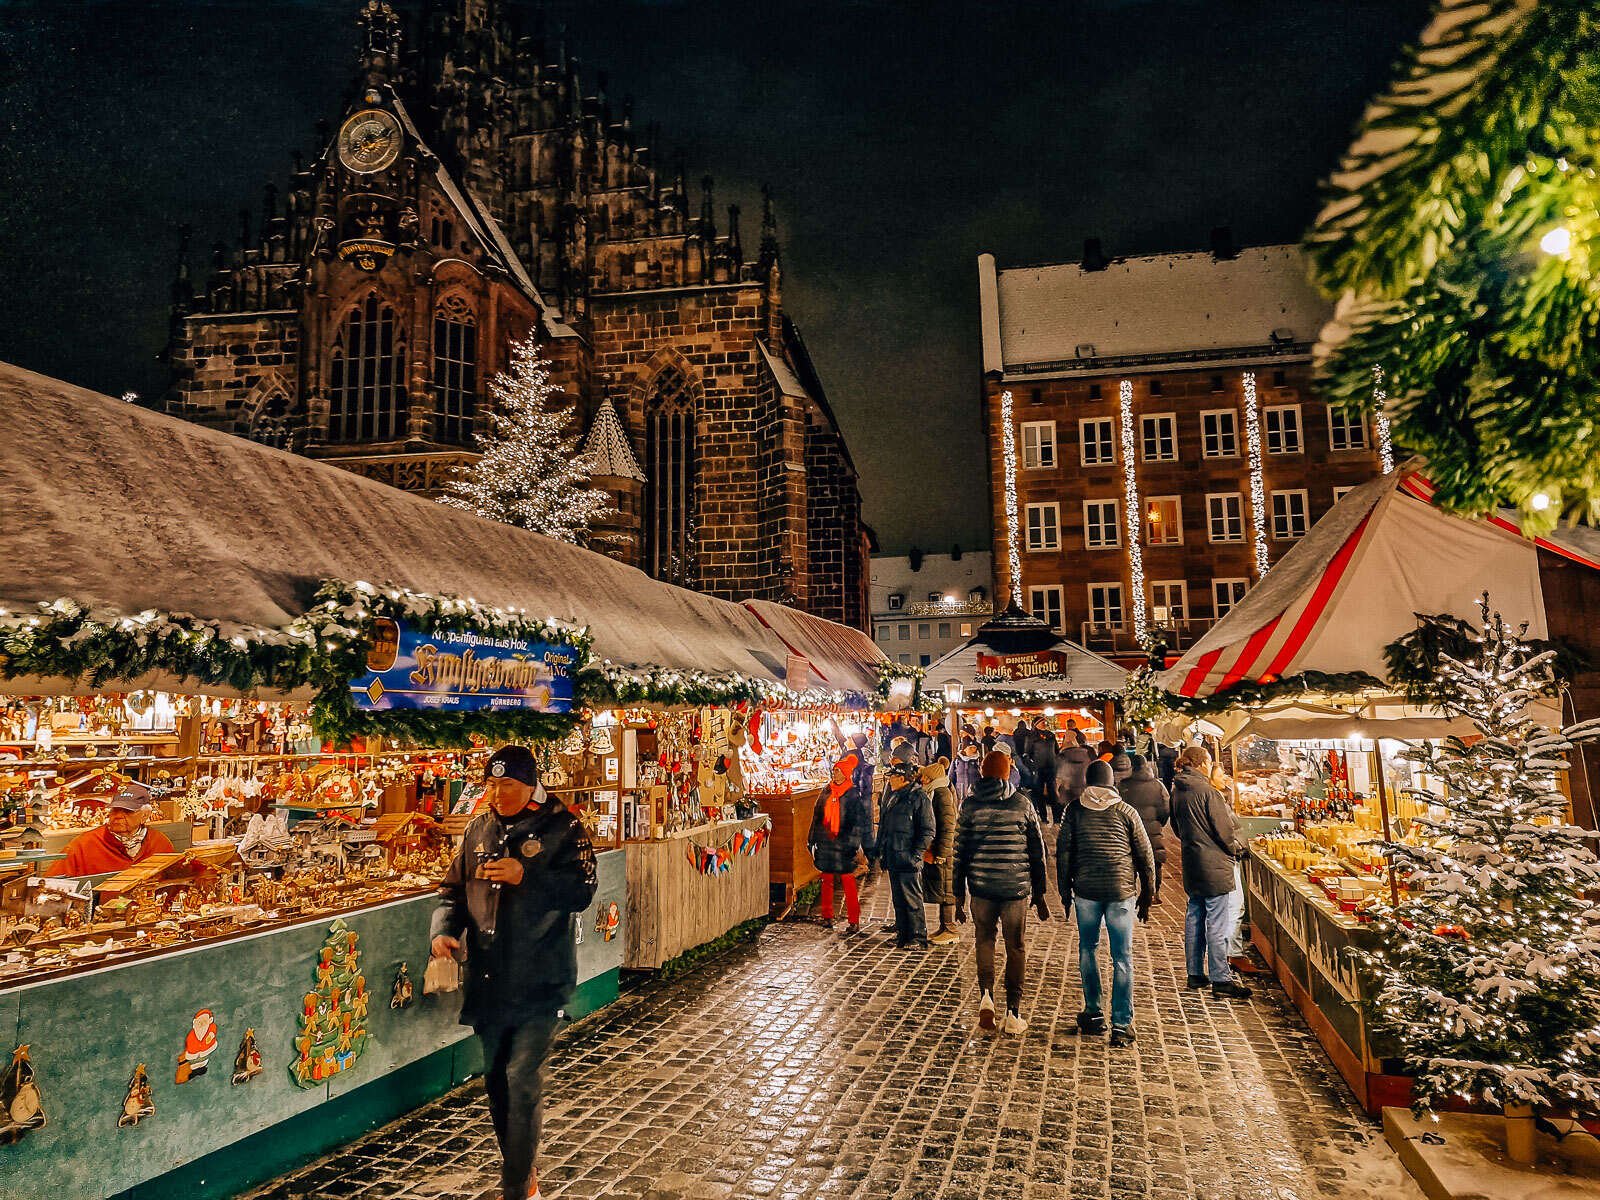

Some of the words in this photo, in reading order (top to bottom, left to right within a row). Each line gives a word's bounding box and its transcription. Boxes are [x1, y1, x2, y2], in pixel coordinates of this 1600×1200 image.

[432, 630, 493, 647] Krppenfiguren
[495, 638, 509, 649] aus
[510, 638, 528, 651] Holz
[544, 651, 569, 665] Original
[441, 696, 460, 705] KRAUS
[490, 697, 522, 706] NÜRNBERG
